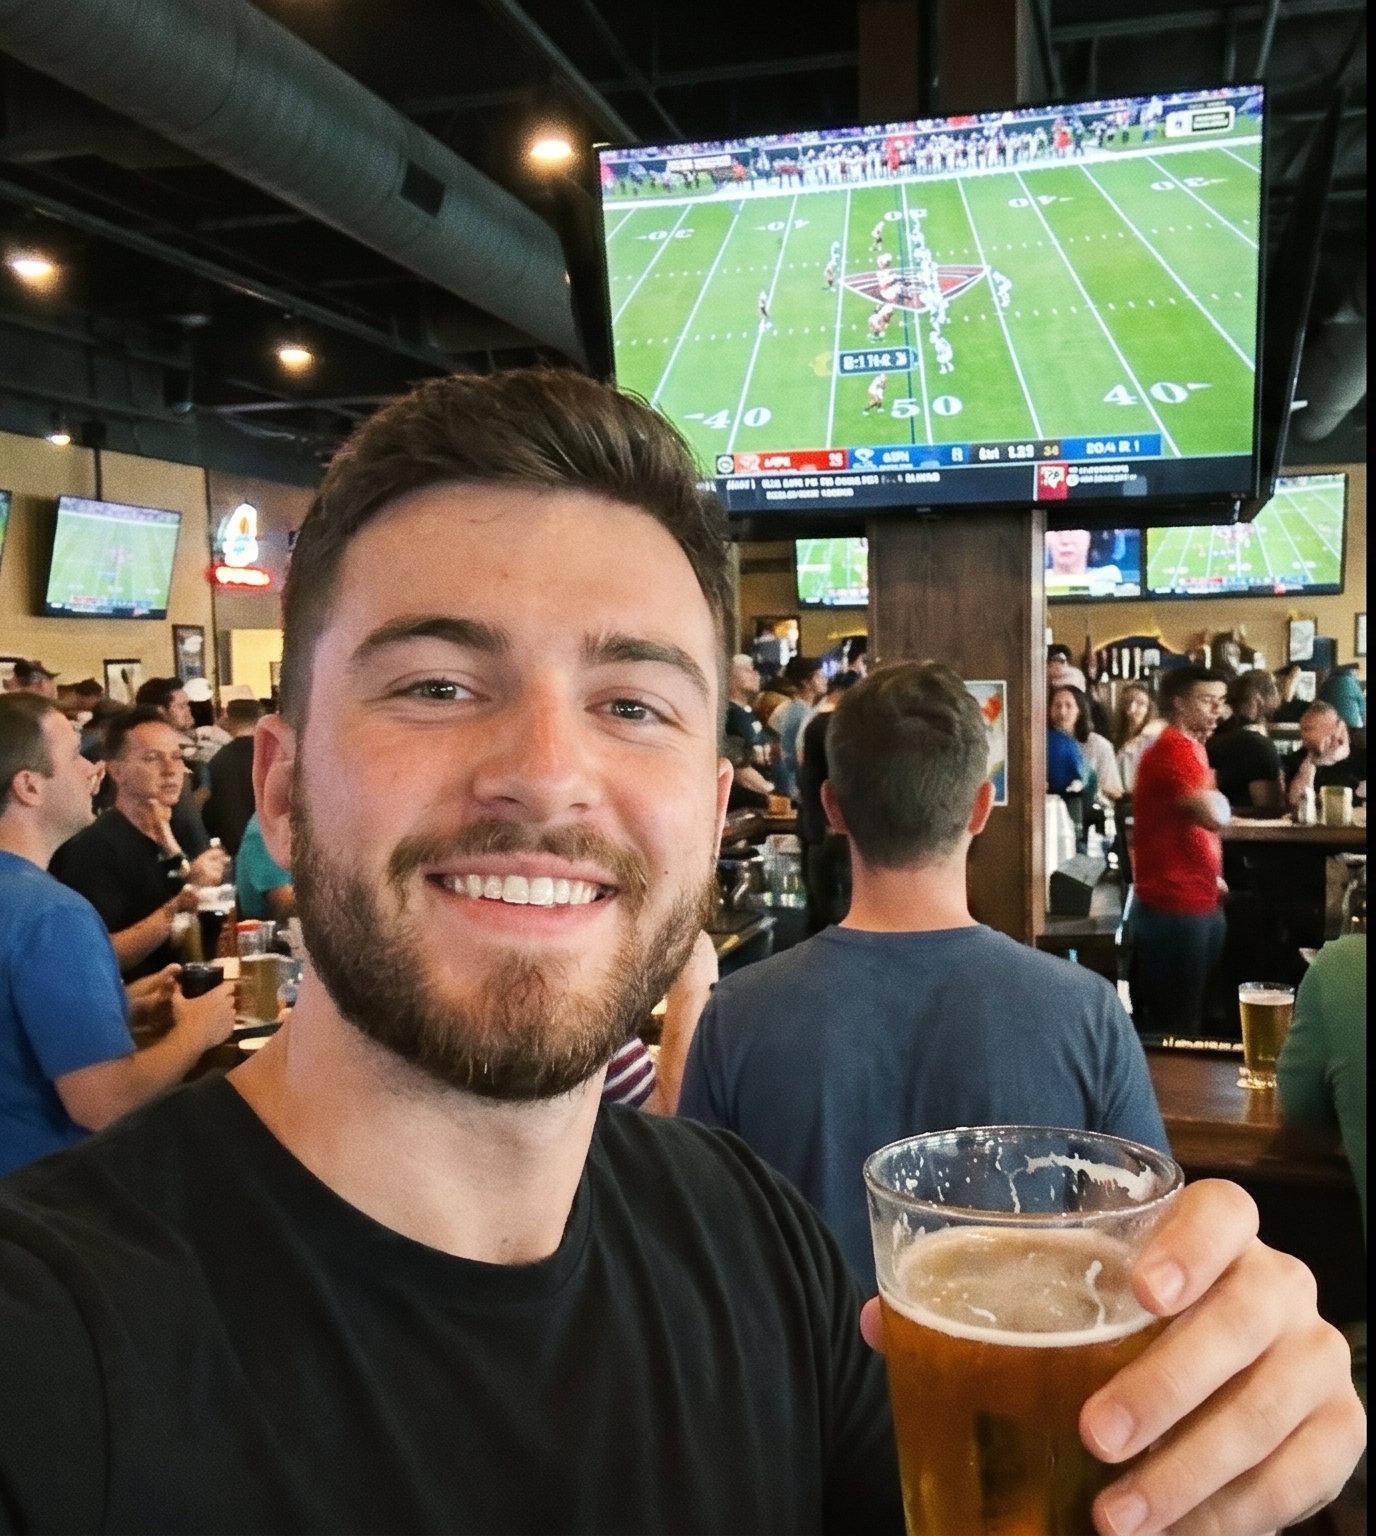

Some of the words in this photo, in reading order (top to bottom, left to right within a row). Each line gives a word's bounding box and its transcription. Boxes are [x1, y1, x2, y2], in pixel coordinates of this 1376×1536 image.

[1103, 382, 1189, 405] 40
[702, 407, 772, 429] 40
[890, 395, 963, 418] 50
